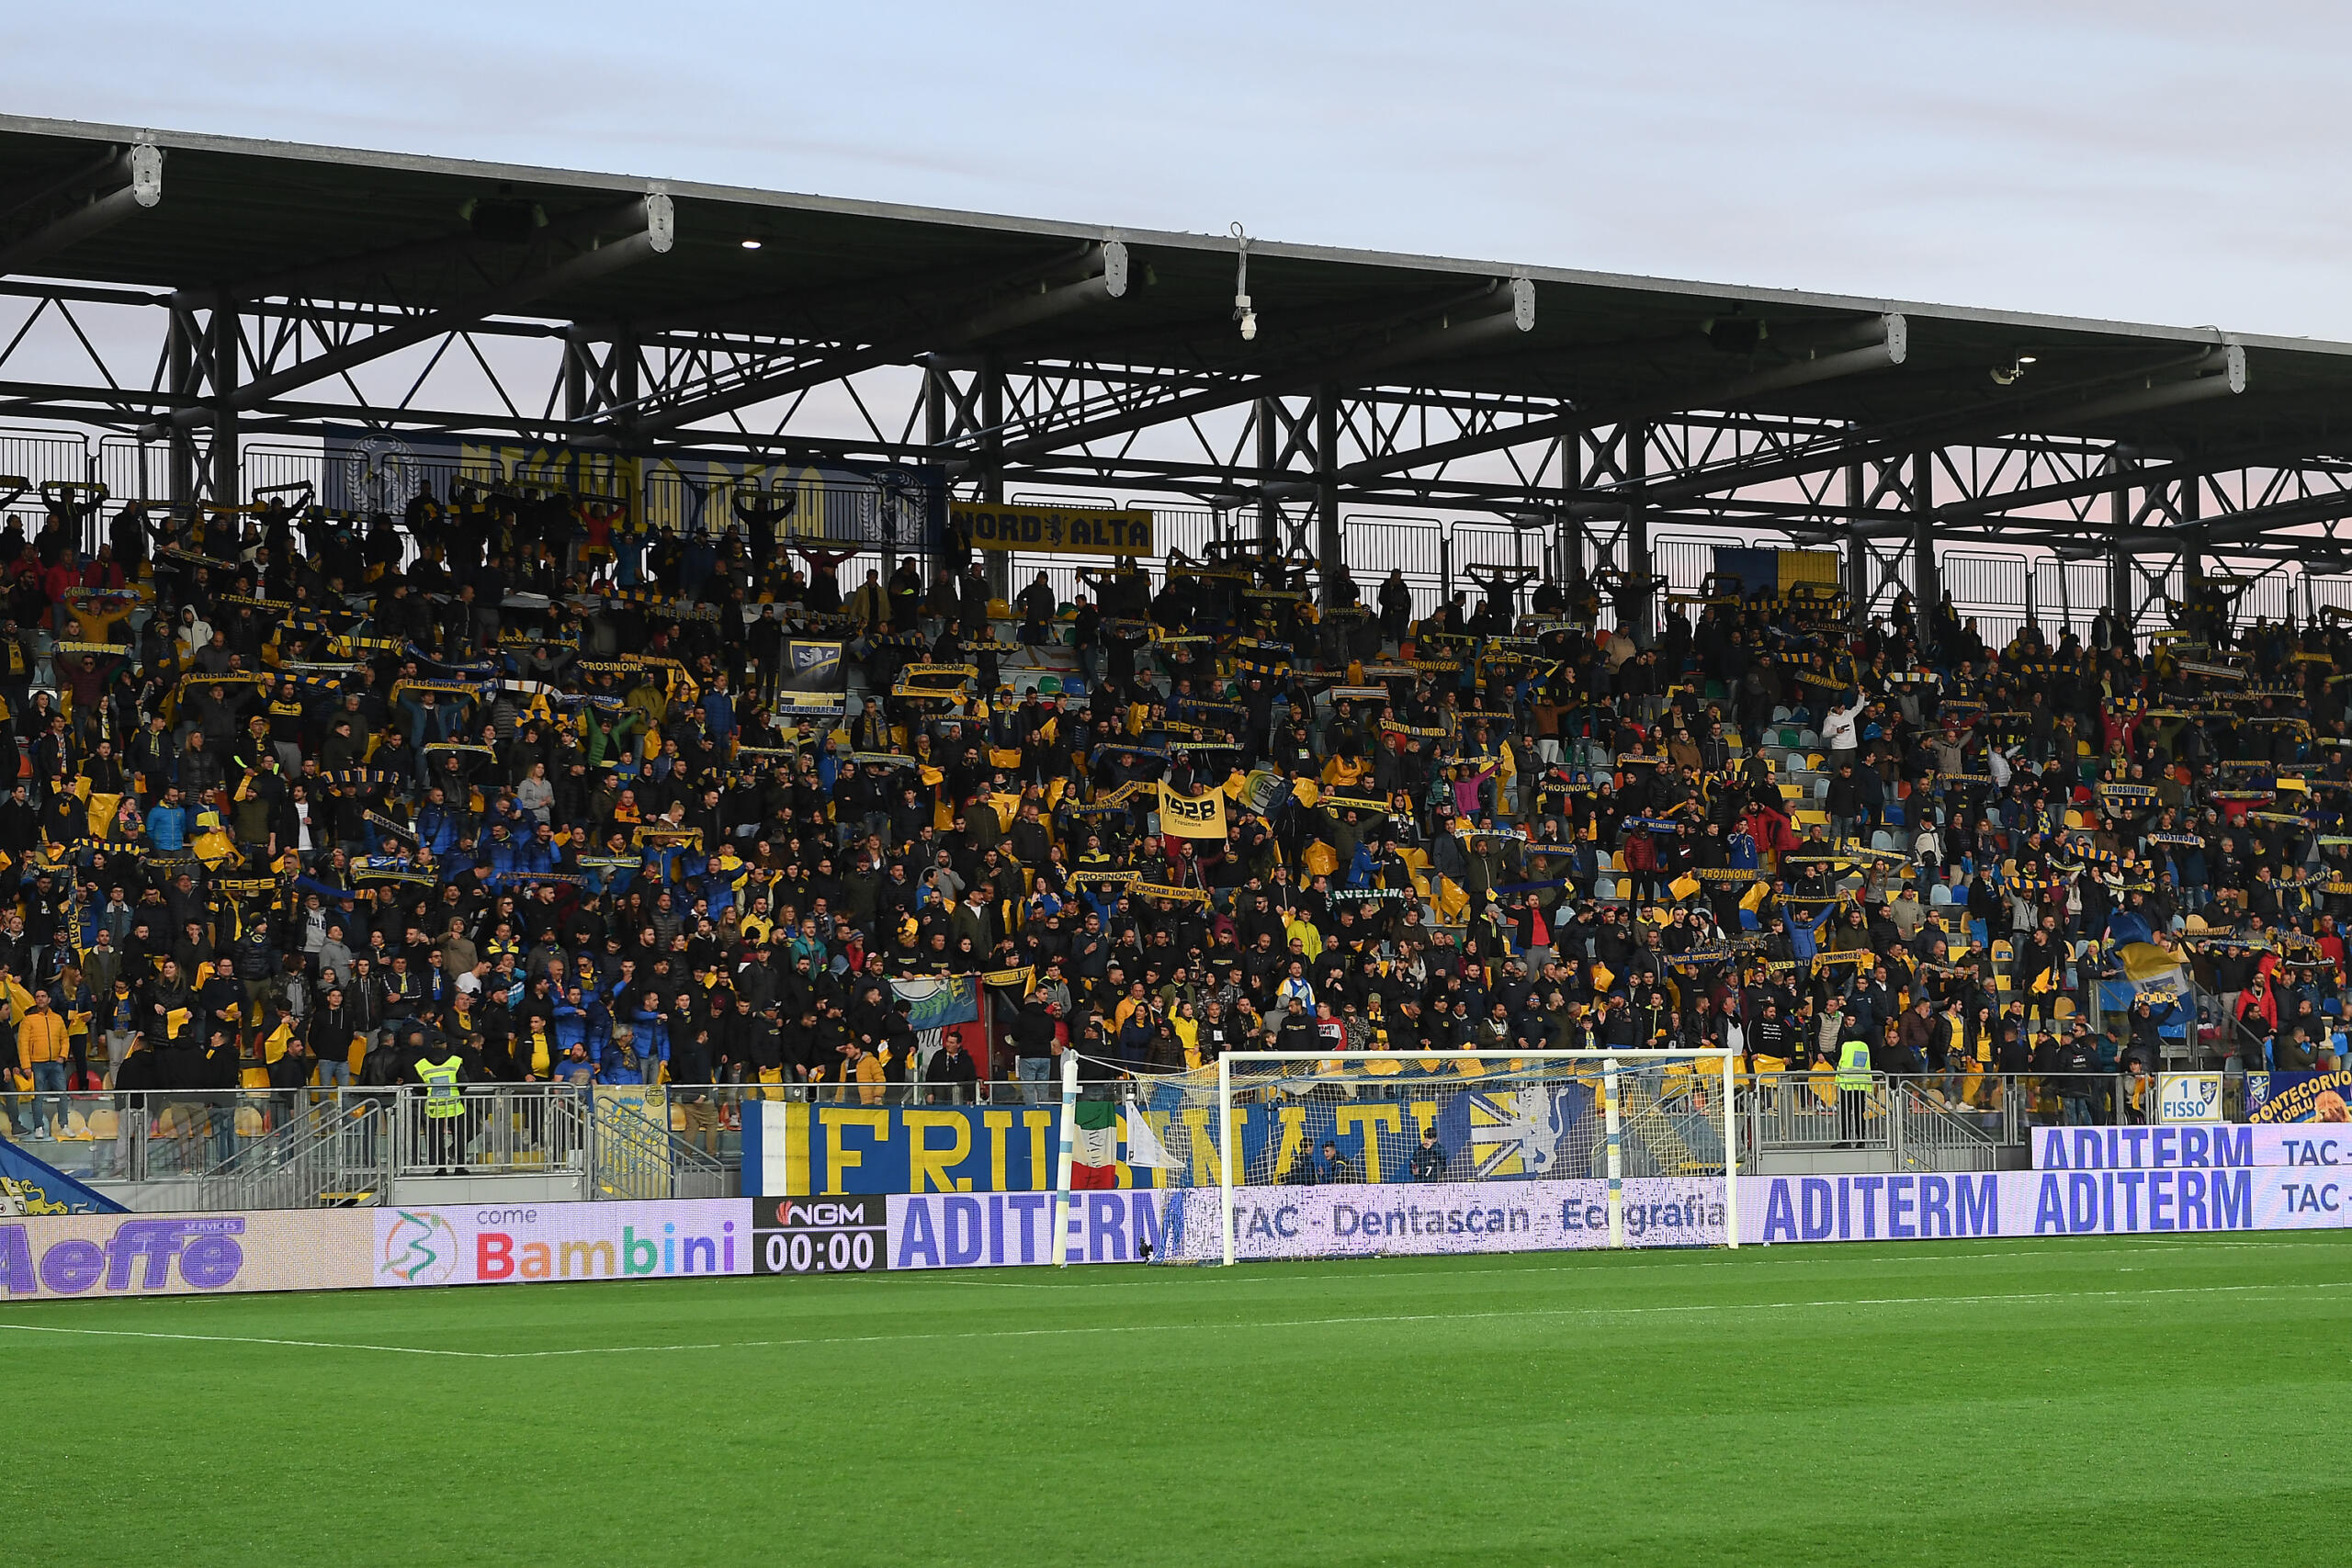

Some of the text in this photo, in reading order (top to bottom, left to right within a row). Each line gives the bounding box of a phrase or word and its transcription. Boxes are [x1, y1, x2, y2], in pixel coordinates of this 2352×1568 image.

[953, 511, 1148, 547] NORD ALTA
[582, 661, 642, 672] FROSINONE
[912, 663, 965, 671] FROSINONE
[189, 671, 252, 681] FROSINONE
[1805, 674, 1848, 690] FROSINONE
[406, 679, 462, 690] FROSINONE
[1950, 700, 1982, 708] FROSINONE
[1381, 720, 1447, 737] CURVA NORD
[1177, 742, 1234, 750] FROSINONE
[1941, 773, 1990, 782] FROSINONE
[1545, 781, 1592, 793] FROSINONE
[2108, 785, 2150, 795] FROSINONE
[1074, 803, 1123, 812] FROSINONE
[1164, 793, 1216, 820] 1928
[1078, 873, 1135, 881] FROSINONE
[1702, 867, 1754, 880] FROSINONE
[219, 879, 277, 889] 1928
[1136, 883, 1170, 896] CIOCIARI
[1824, 953, 1861, 964] FROSINONE
[2181, 1079, 2188, 1098] 1
[2248, 1070, 2352, 1123] PONTECORVO
[2164, 1101, 2205, 1117] FISSO
[2042, 1127, 2338, 1168] ADITERM TAC
[1762, 1175, 1999, 1241] ADITERM
[2034, 1169, 2340, 1234] ADITERM TAC
[477, 1207, 537, 1225] come
[787, 1202, 865, 1226] NGM
[1232, 1204, 1299, 1238] TAC
[1333, 1204, 1530, 1236] Dentascan
[1563, 1194, 1725, 1236] Ecgrafia
[184, 1221, 238, 1233] SERVICES
[898, 1192, 1183, 1268] ADITERM
[477, 1220, 736, 1280] Bambini
[765, 1232, 875, 1272] 00:00
